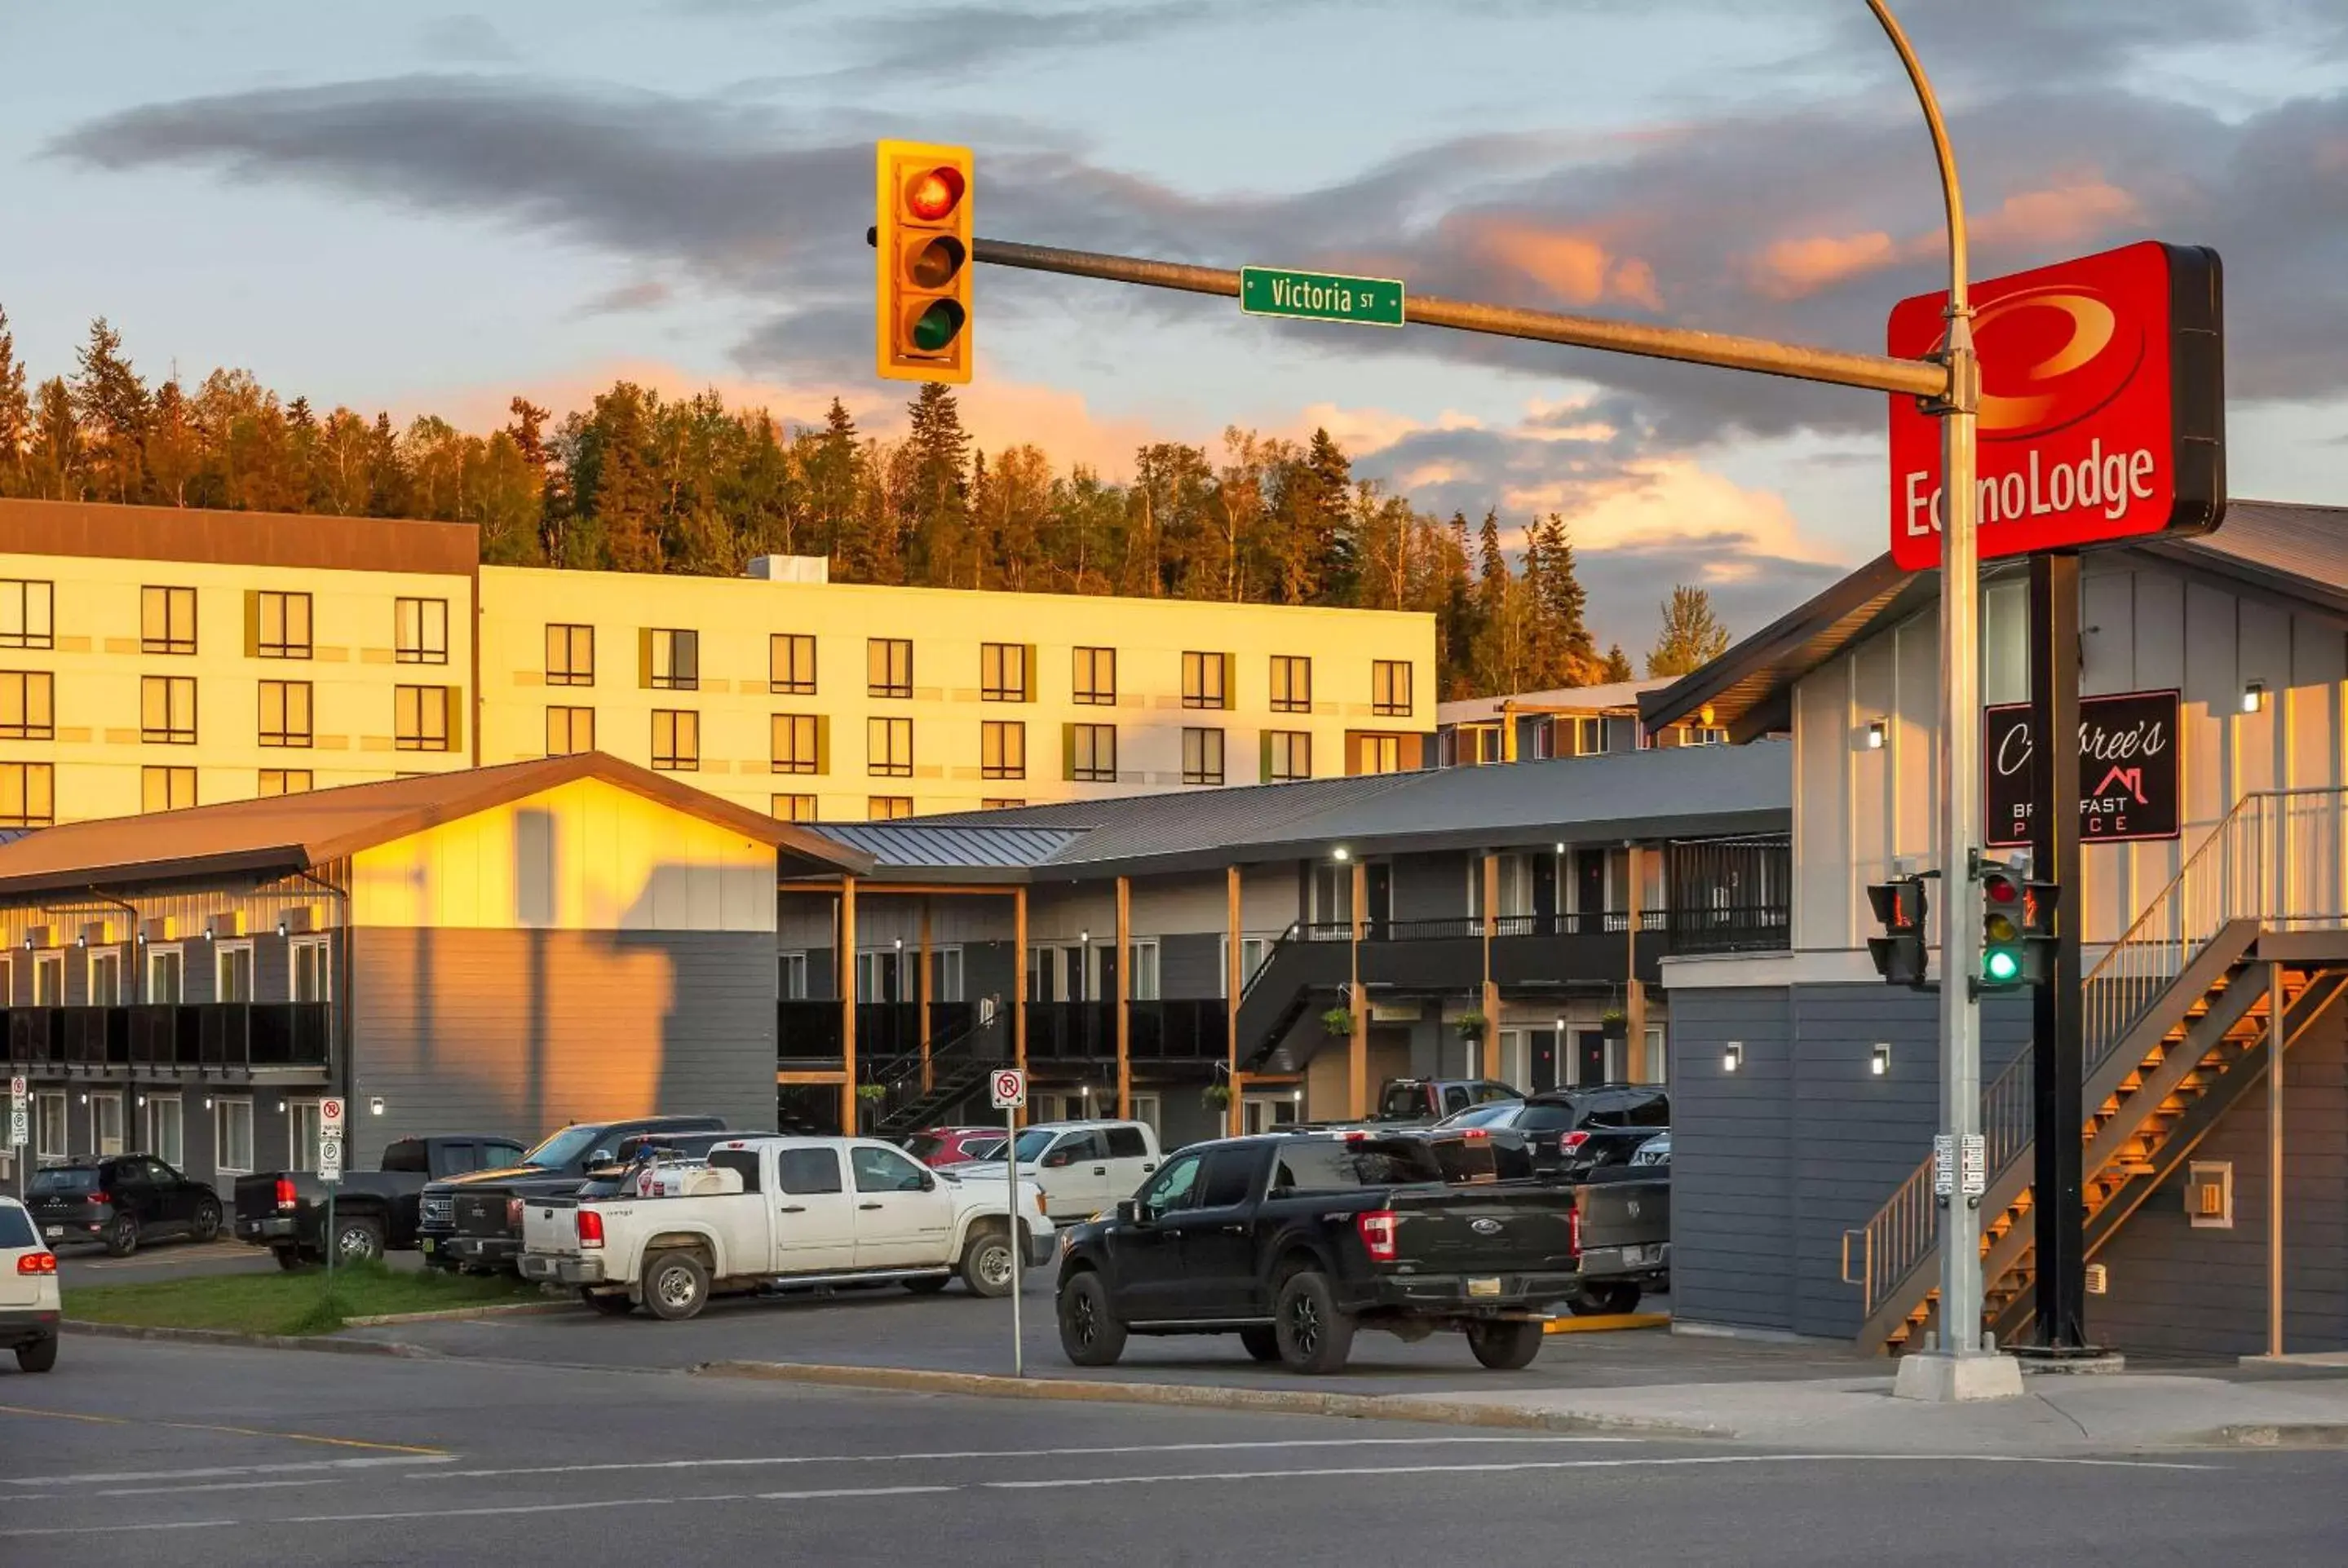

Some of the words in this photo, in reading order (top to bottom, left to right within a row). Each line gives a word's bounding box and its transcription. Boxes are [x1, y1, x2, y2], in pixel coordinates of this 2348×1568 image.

[1272, 278, 1351, 312] Victoria
[1360, 294, 1374, 308] ST
[1906, 438, 2154, 536] EcnoLodge
[2014, 816, 2127, 837] PCE
